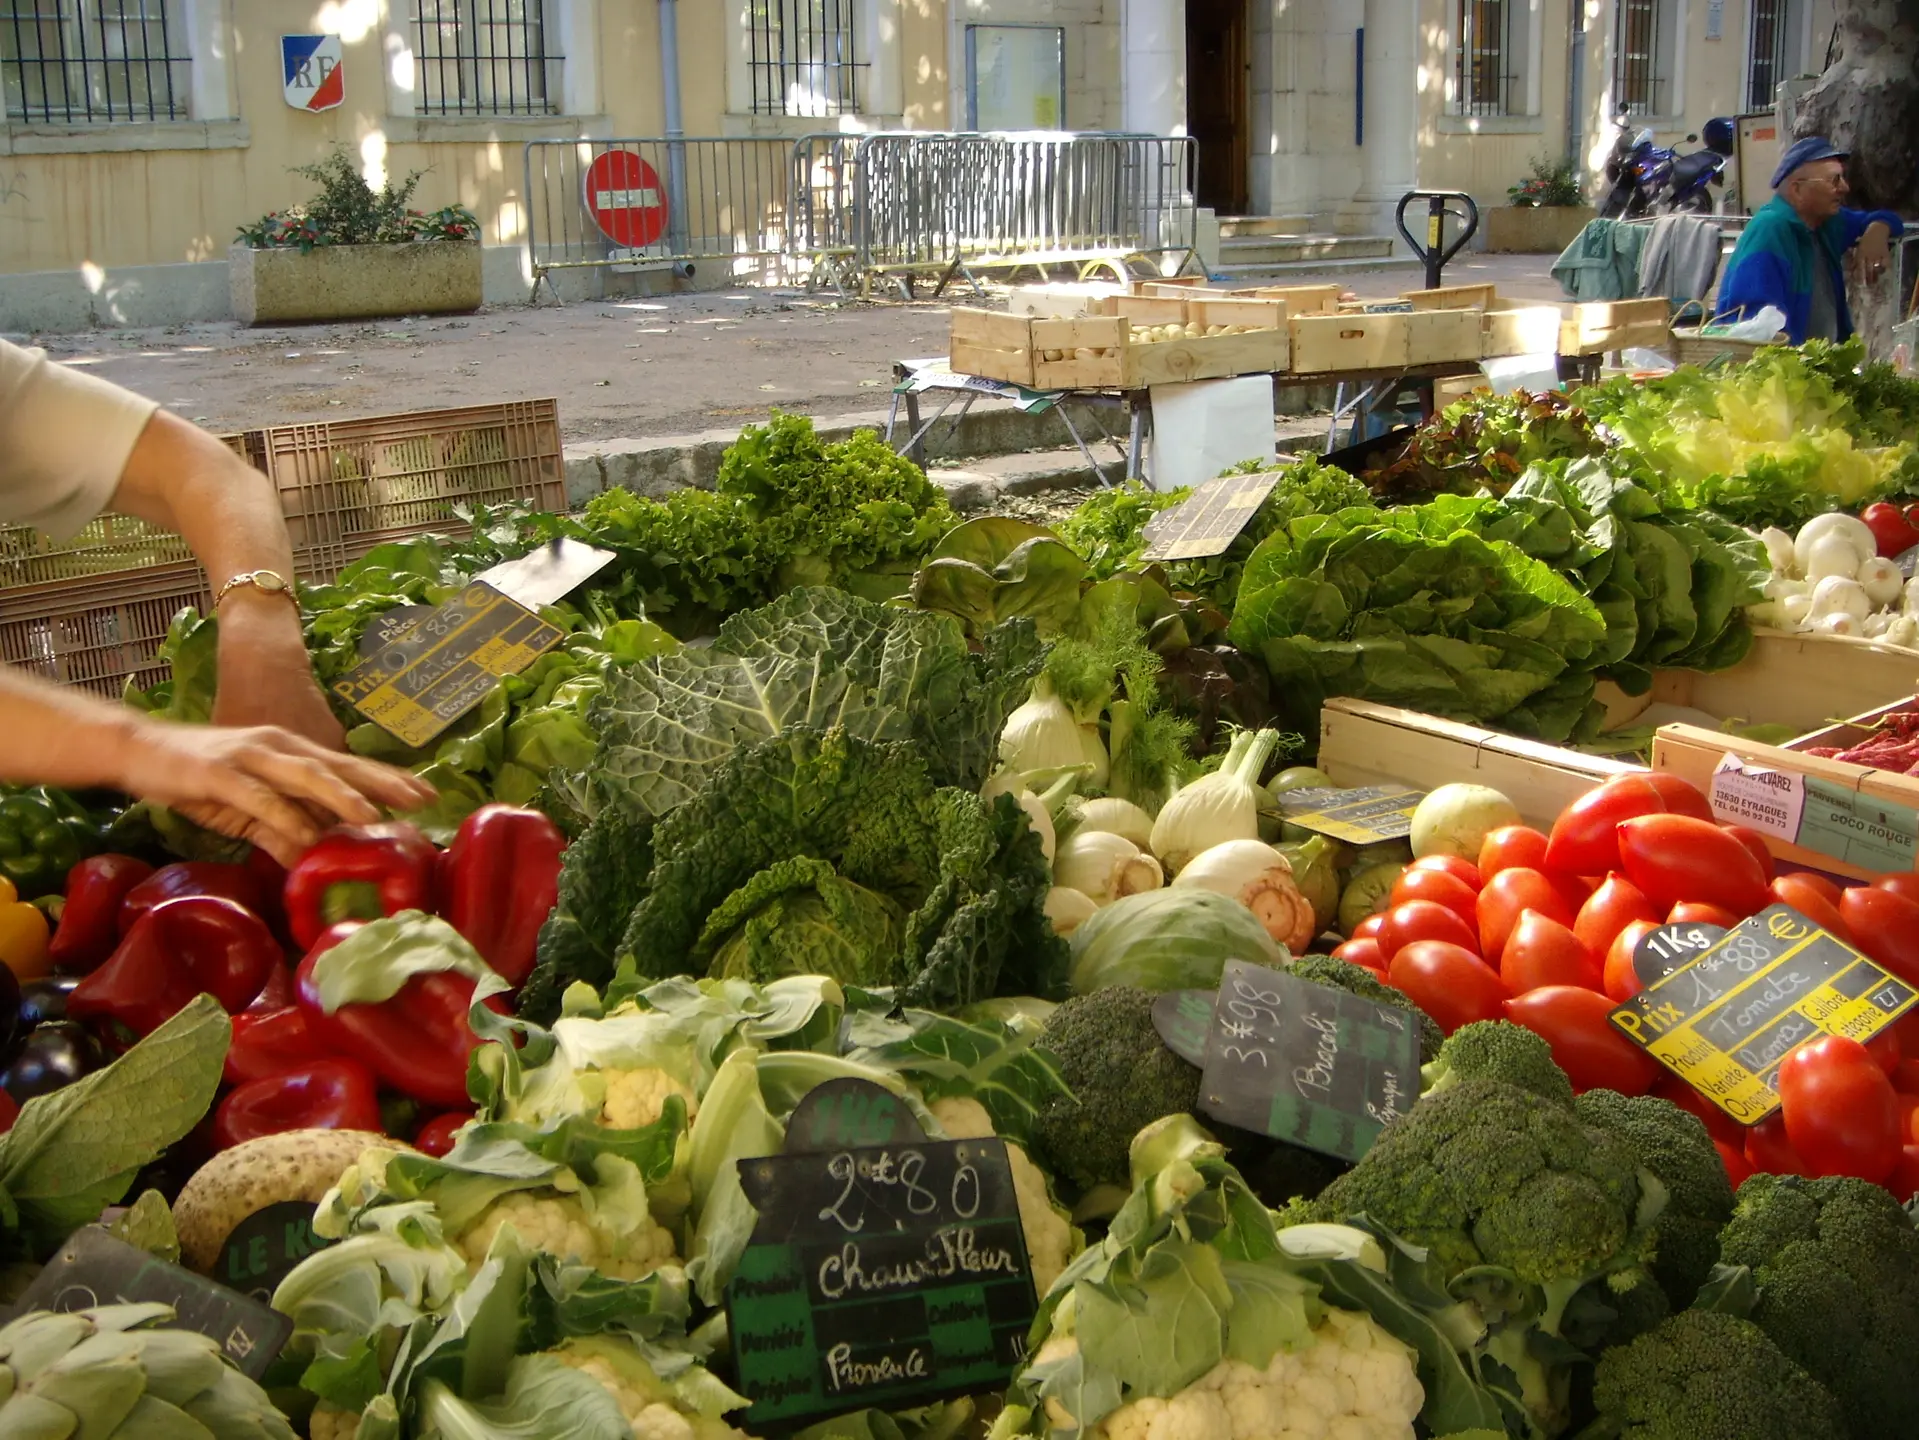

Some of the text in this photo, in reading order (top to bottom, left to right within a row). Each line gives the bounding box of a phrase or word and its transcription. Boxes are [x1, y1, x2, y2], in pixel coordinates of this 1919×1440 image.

[293, 55, 336, 88] RF
[333, 667, 389, 703] Prix
[1758, 771, 1792, 793] ALVAREZ
[1714, 799, 1727, 810] TEL
[1729, 805, 1739, 813] 04
[1716, 790, 1788, 820] 13630 EYRAGUES
[1830, 812, 1912, 847] COCO ROUGE
[1708, 972, 1811, 1036] Tomate
[1801, 990, 1849, 1021] Calibre
[1611, 1001, 1685, 1044] Prix
[1660, 1036, 1716, 1075] Produit
[1696, 1061, 1747, 1097] Variété
[1723, 1084, 1775, 1117] Origine
[228, 1234, 269, 1282] LE
